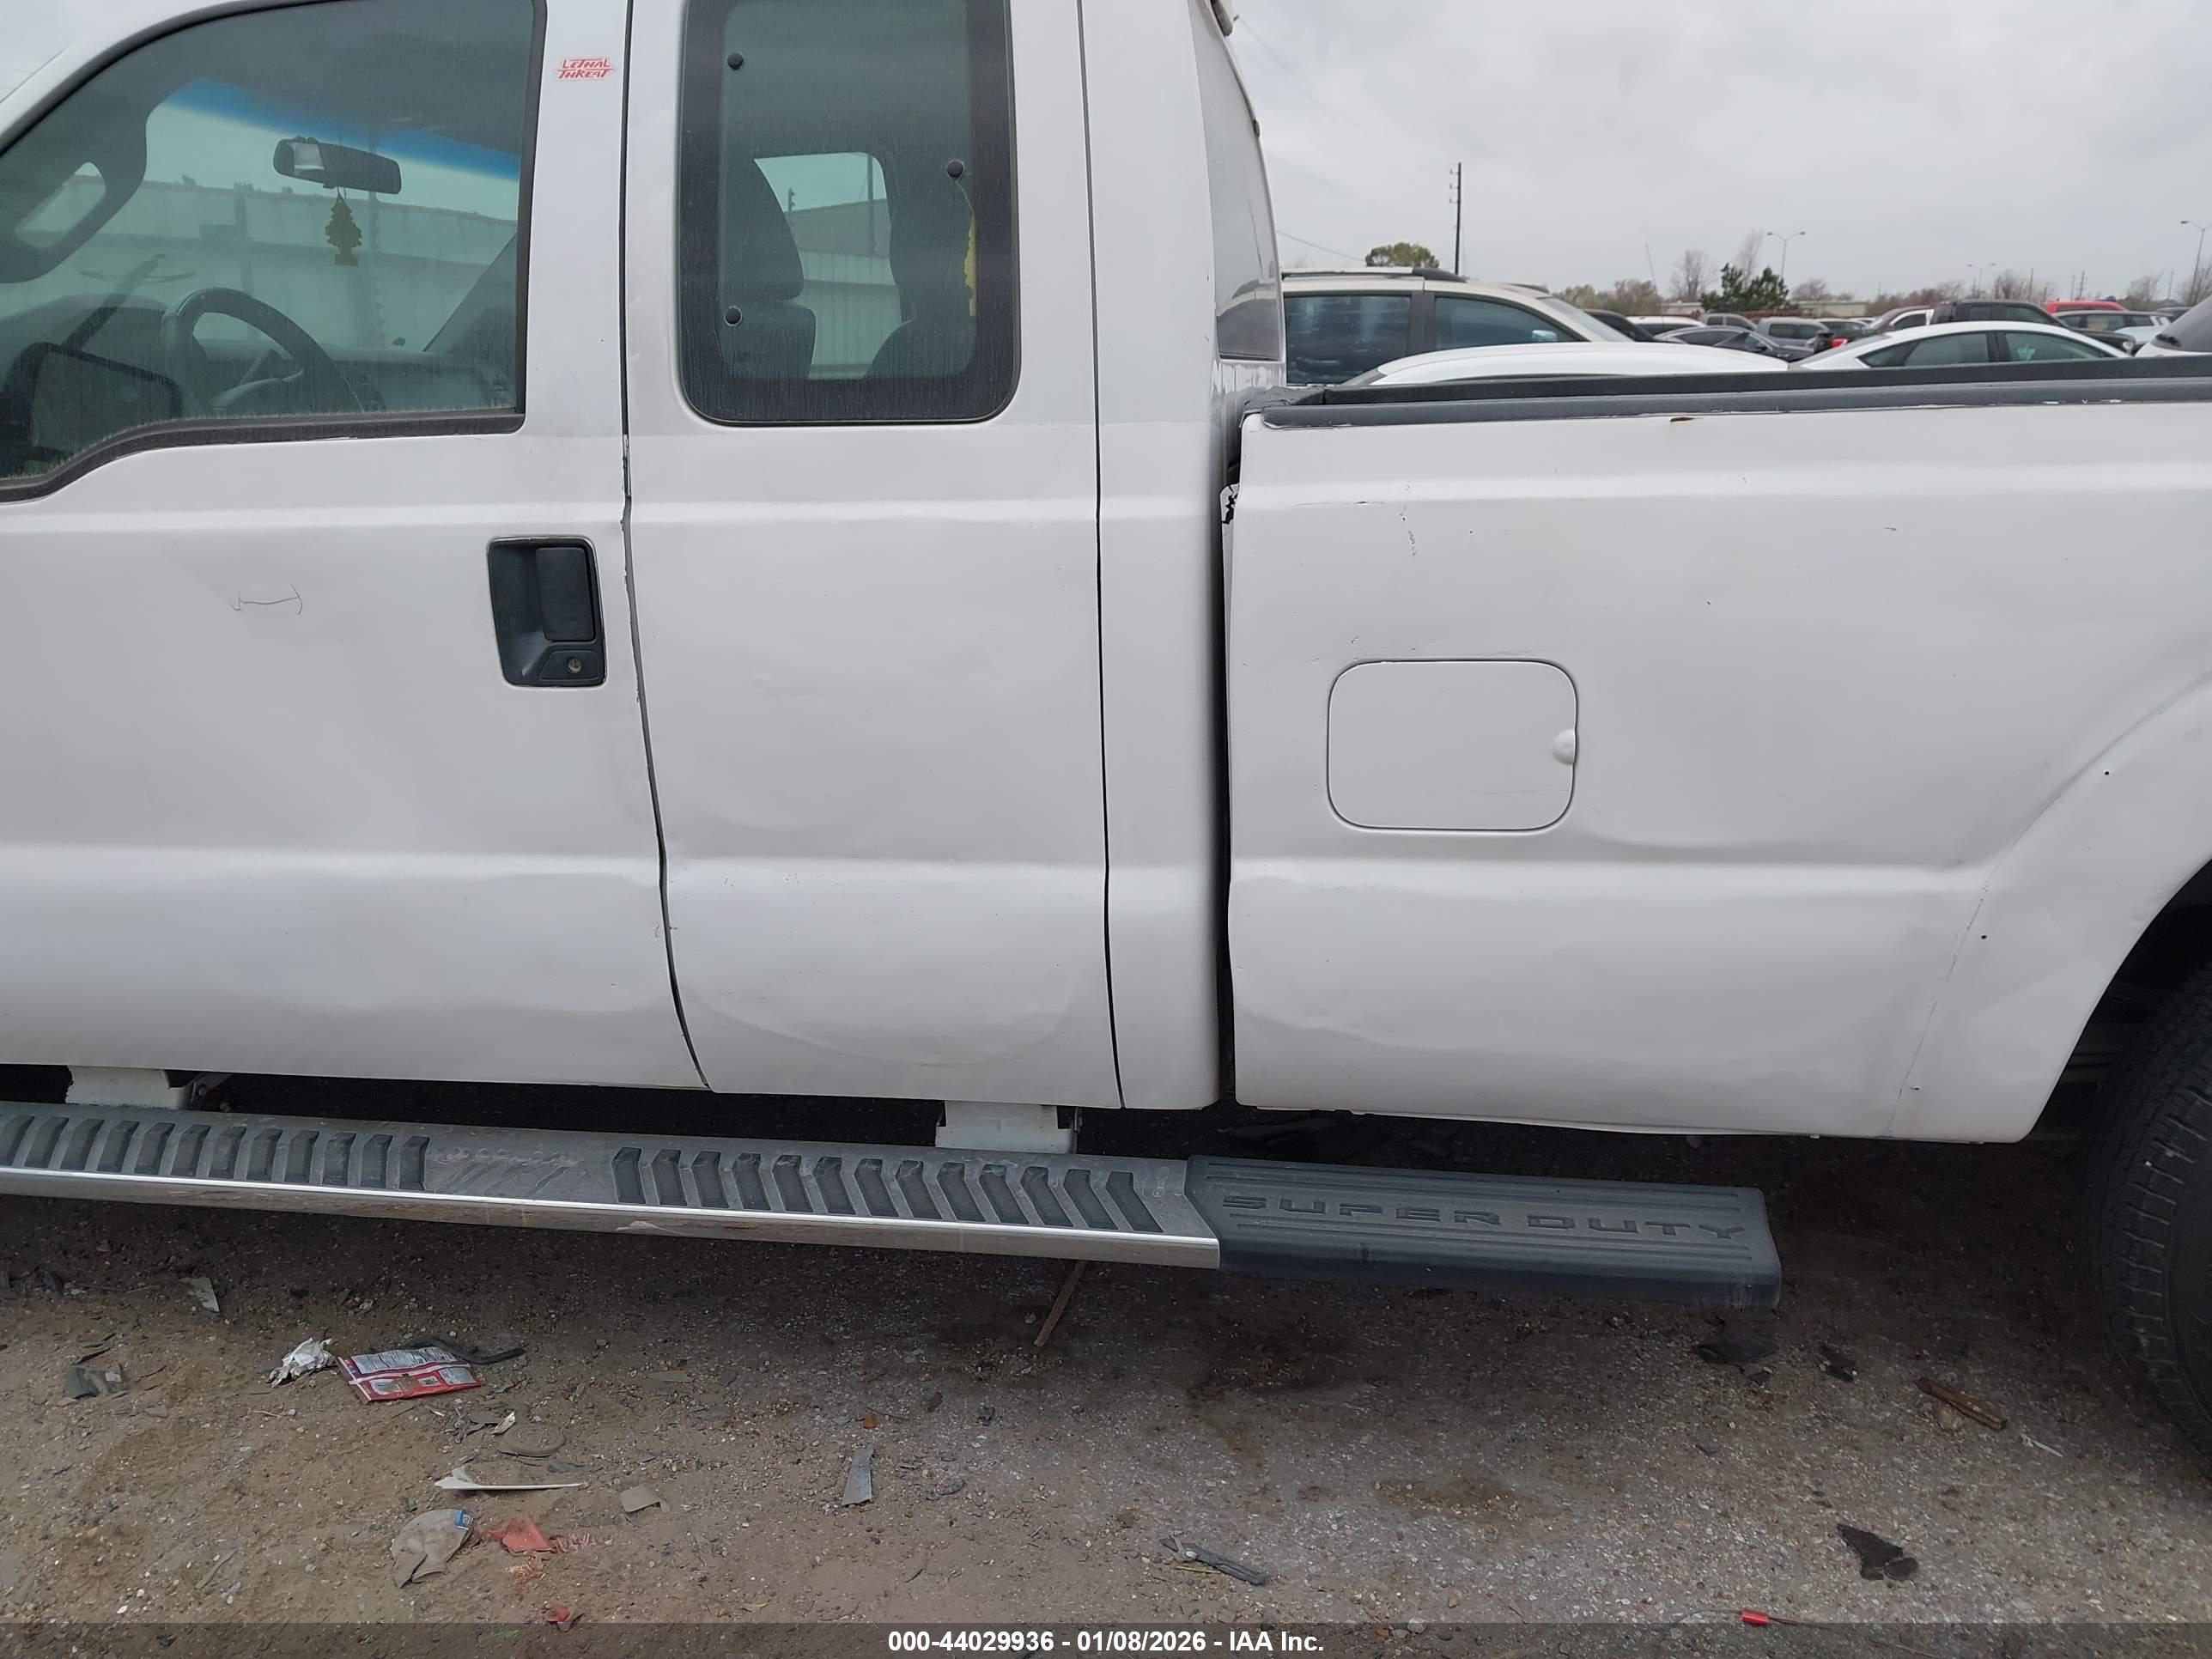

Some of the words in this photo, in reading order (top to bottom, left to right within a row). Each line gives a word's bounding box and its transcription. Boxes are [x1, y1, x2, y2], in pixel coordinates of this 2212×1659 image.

[561, 58, 611, 69] LETHAL
[556, 68, 614, 80] THREAT
[1222, 1194, 1502, 1226] SUPER
[1527, 1212, 1746, 1239] DUTY
